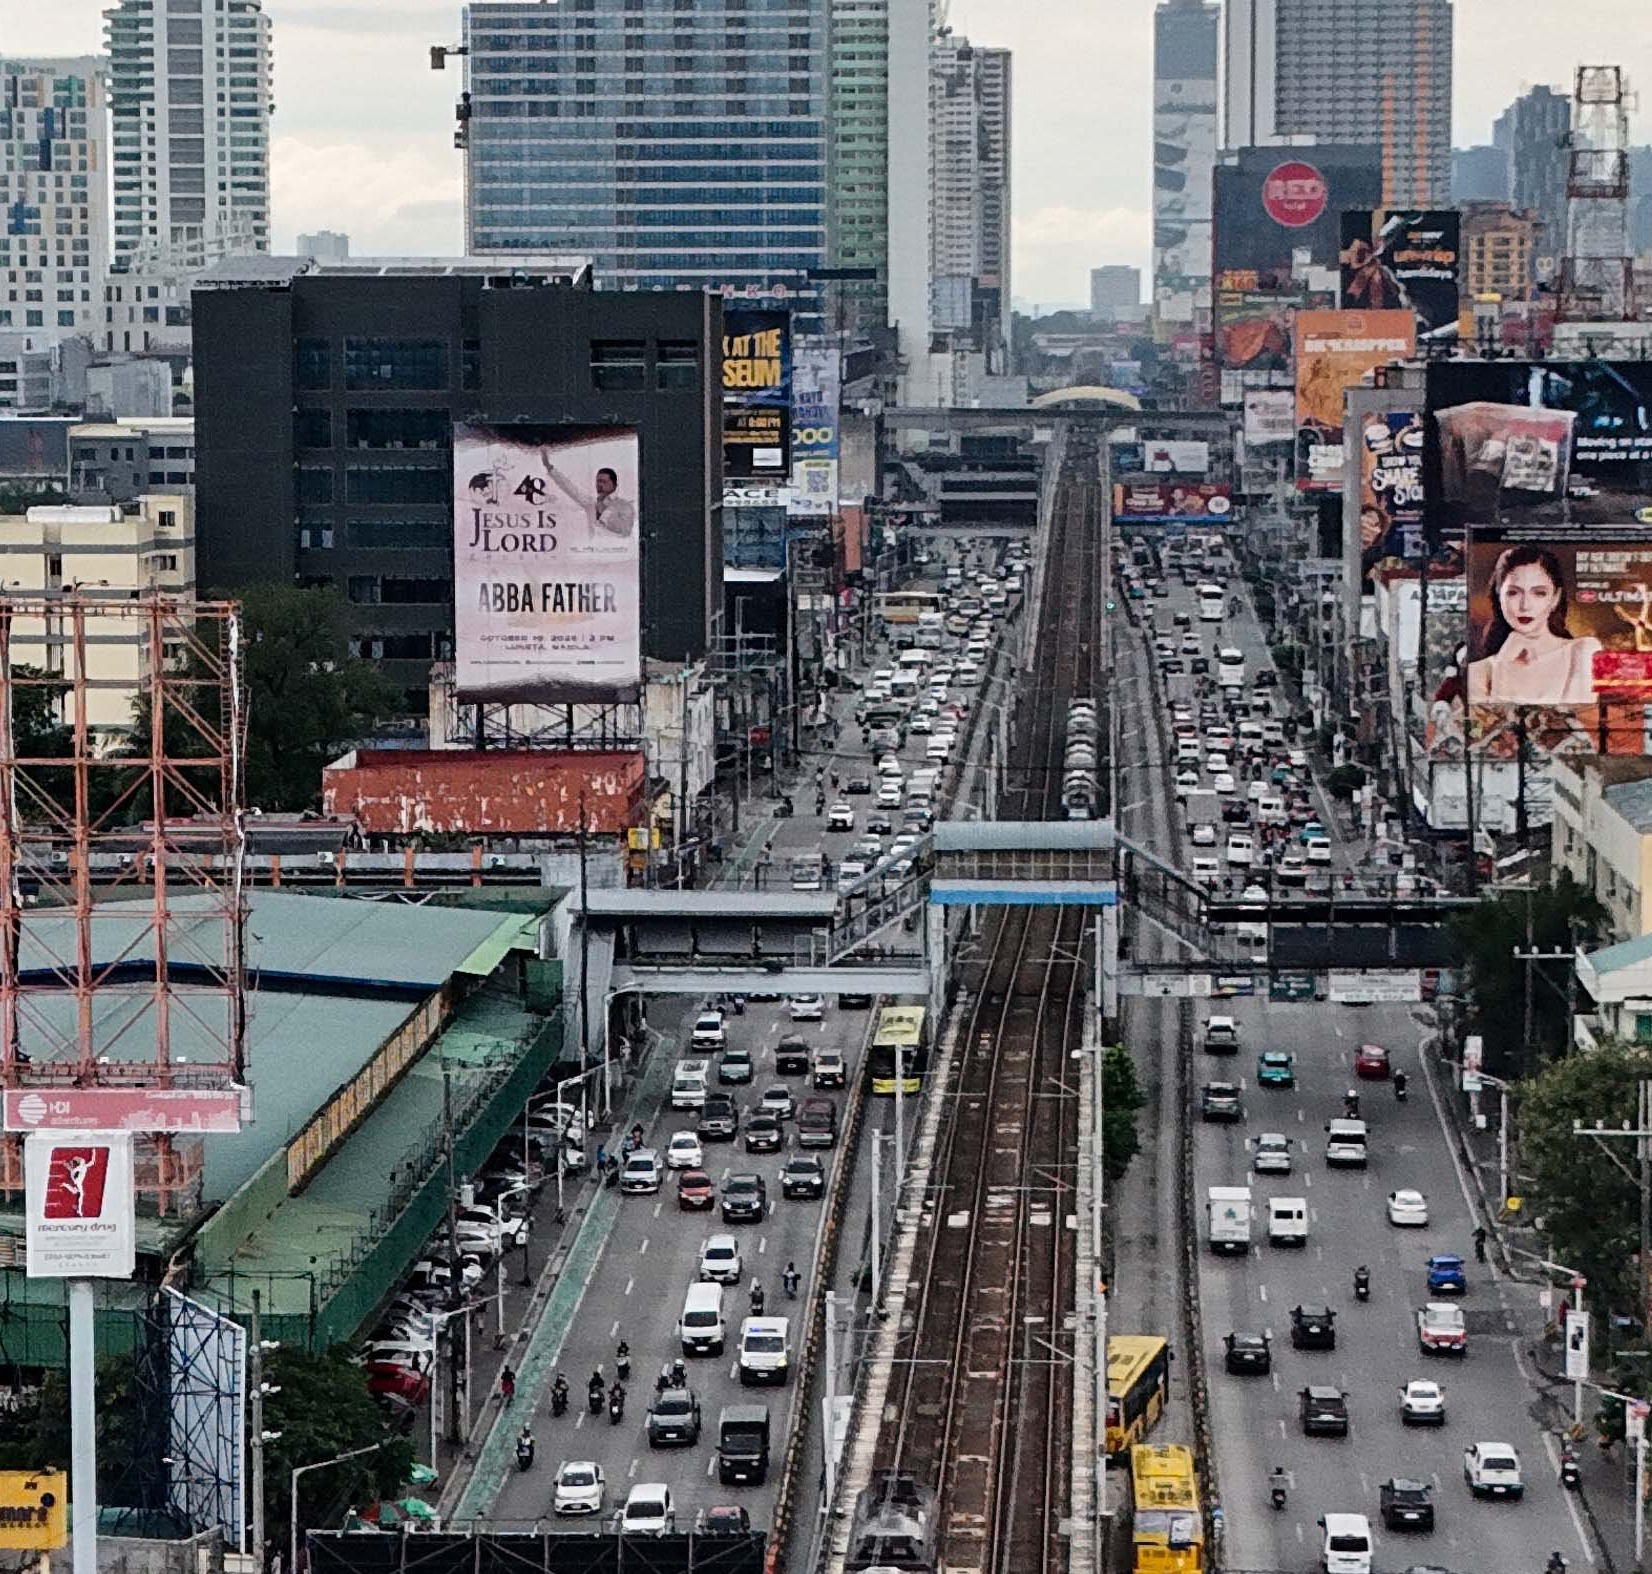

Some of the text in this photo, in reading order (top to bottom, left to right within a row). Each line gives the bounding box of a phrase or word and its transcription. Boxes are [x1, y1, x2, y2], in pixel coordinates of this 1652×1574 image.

[732, 334, 751, 357] AT
[750, 328, 781, 356] THE
[469, 508, 530, 547] JESUS
[483, 529, 557, 552] LORD
[478, 582, 617, 613] ABBA FATHER
[37, 1222, 117, 1233] mercury drug
